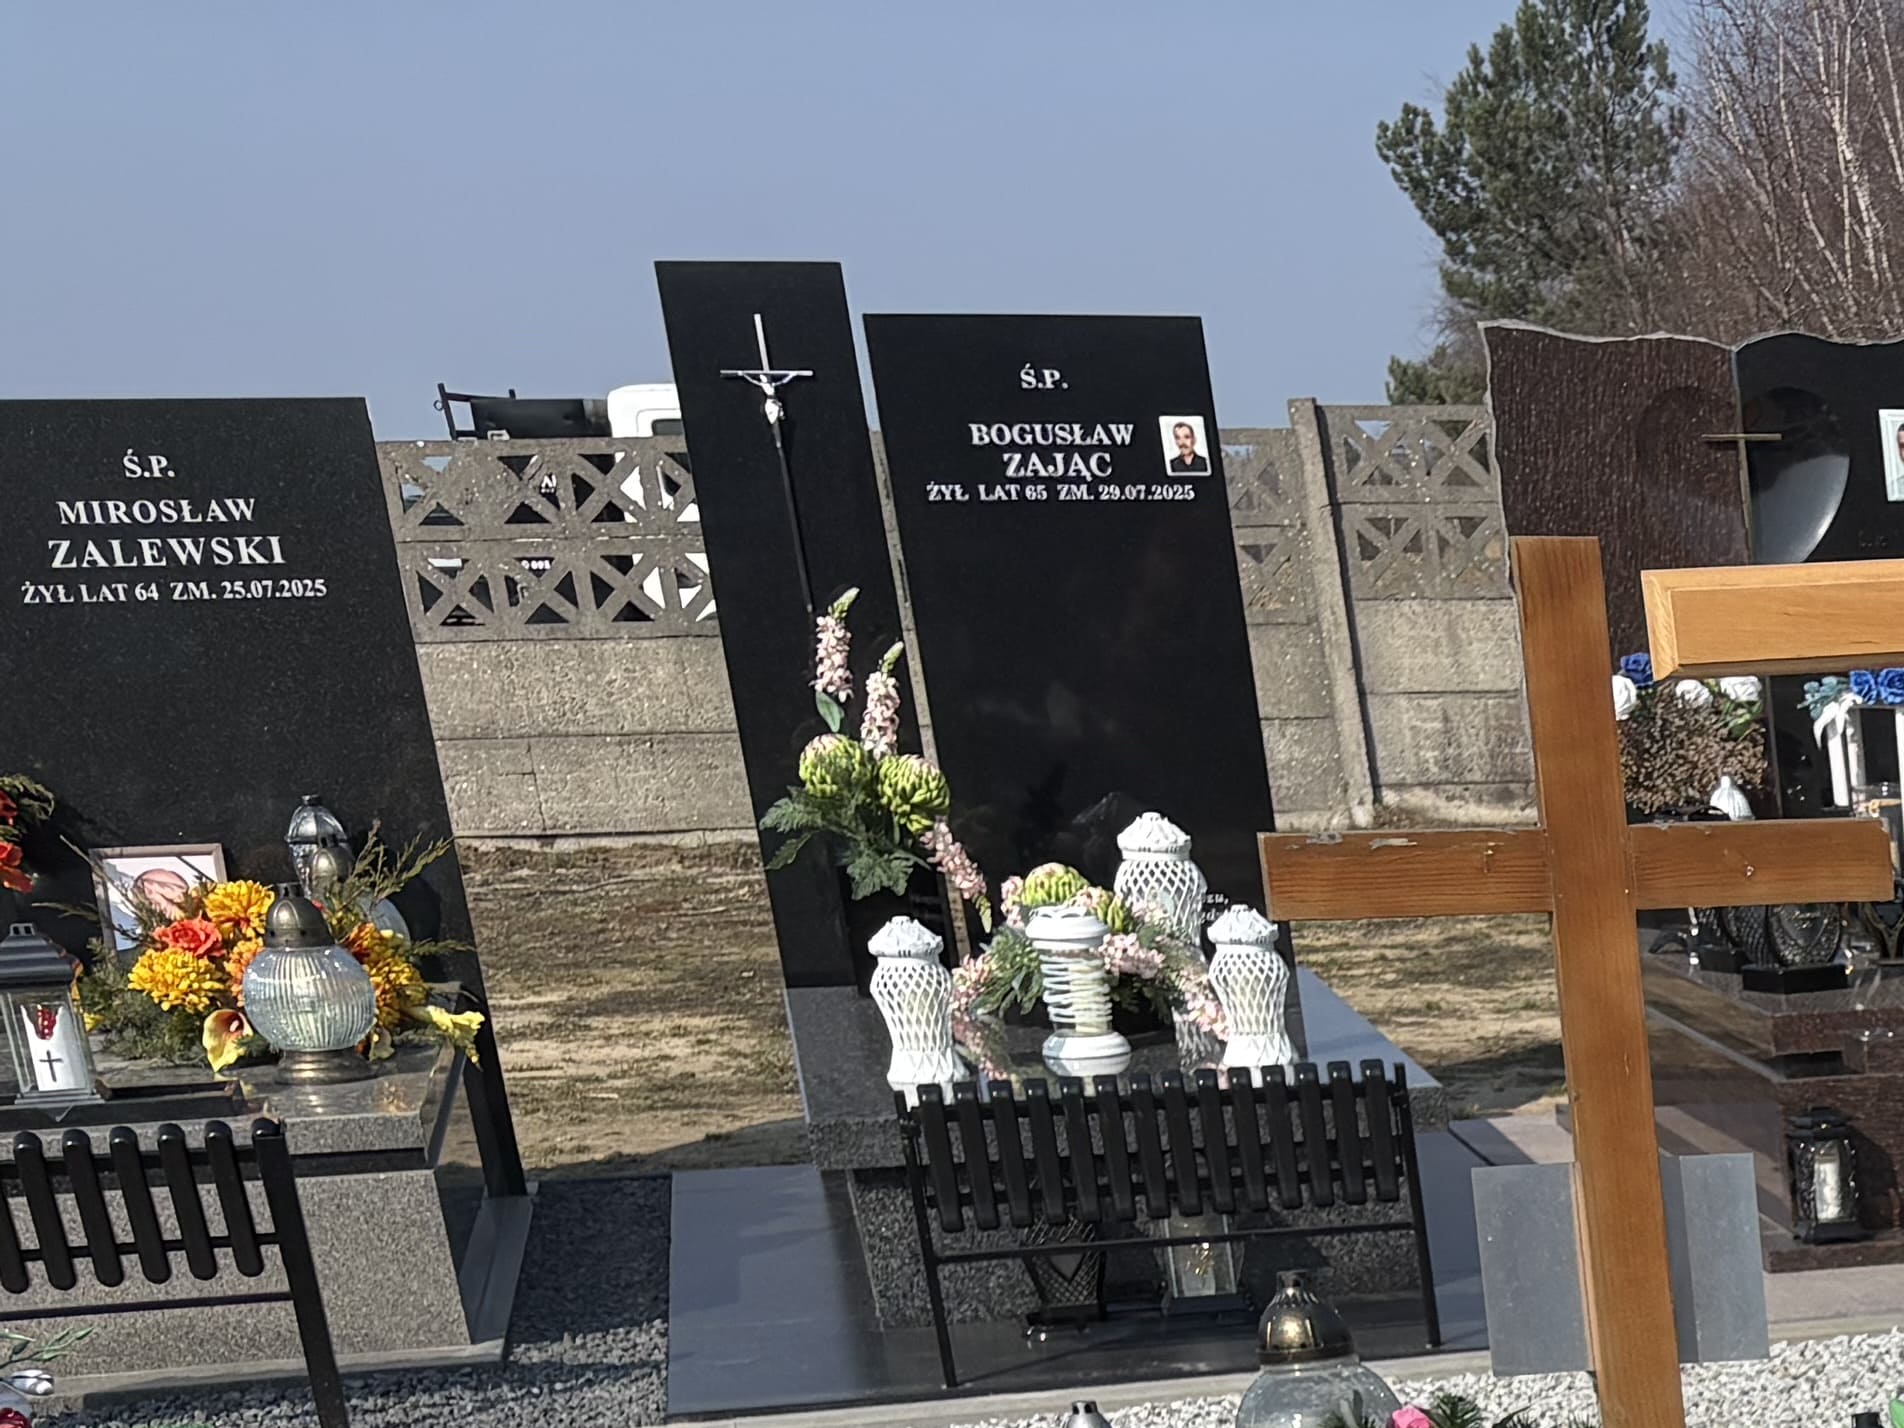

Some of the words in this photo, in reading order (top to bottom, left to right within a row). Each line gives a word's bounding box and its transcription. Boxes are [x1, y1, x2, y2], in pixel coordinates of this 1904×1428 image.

[1019, 363, 1069, 390] Ś.P.
[967, 422, 1134, 447] BOGUSŁAW
[122, 448, 177, 479] Ś.P.
[1002, 451, 1113, 482] ZAJĄC
[925, 480, 970, 502] ŻYŁ
[977, 483, 1021, 501] LAT
[1024, 483, 1049, 501] 65
[1056, 483, 1095, 501] ZM.
[1098, 483, 1196, 501] 29.07.2025
[55, 497, 256, 526] MIROSŁAW
[47, 535, 287, 569] ZALEWSKI
[21, 580, 75, 604] ŻYŁ
[79, 582, 129, 602] LAT
[133, 581, 160, 602] 64
[169, 580, 218, 601] ZM.
[220, 578, 328, 600] 25.07.2025
